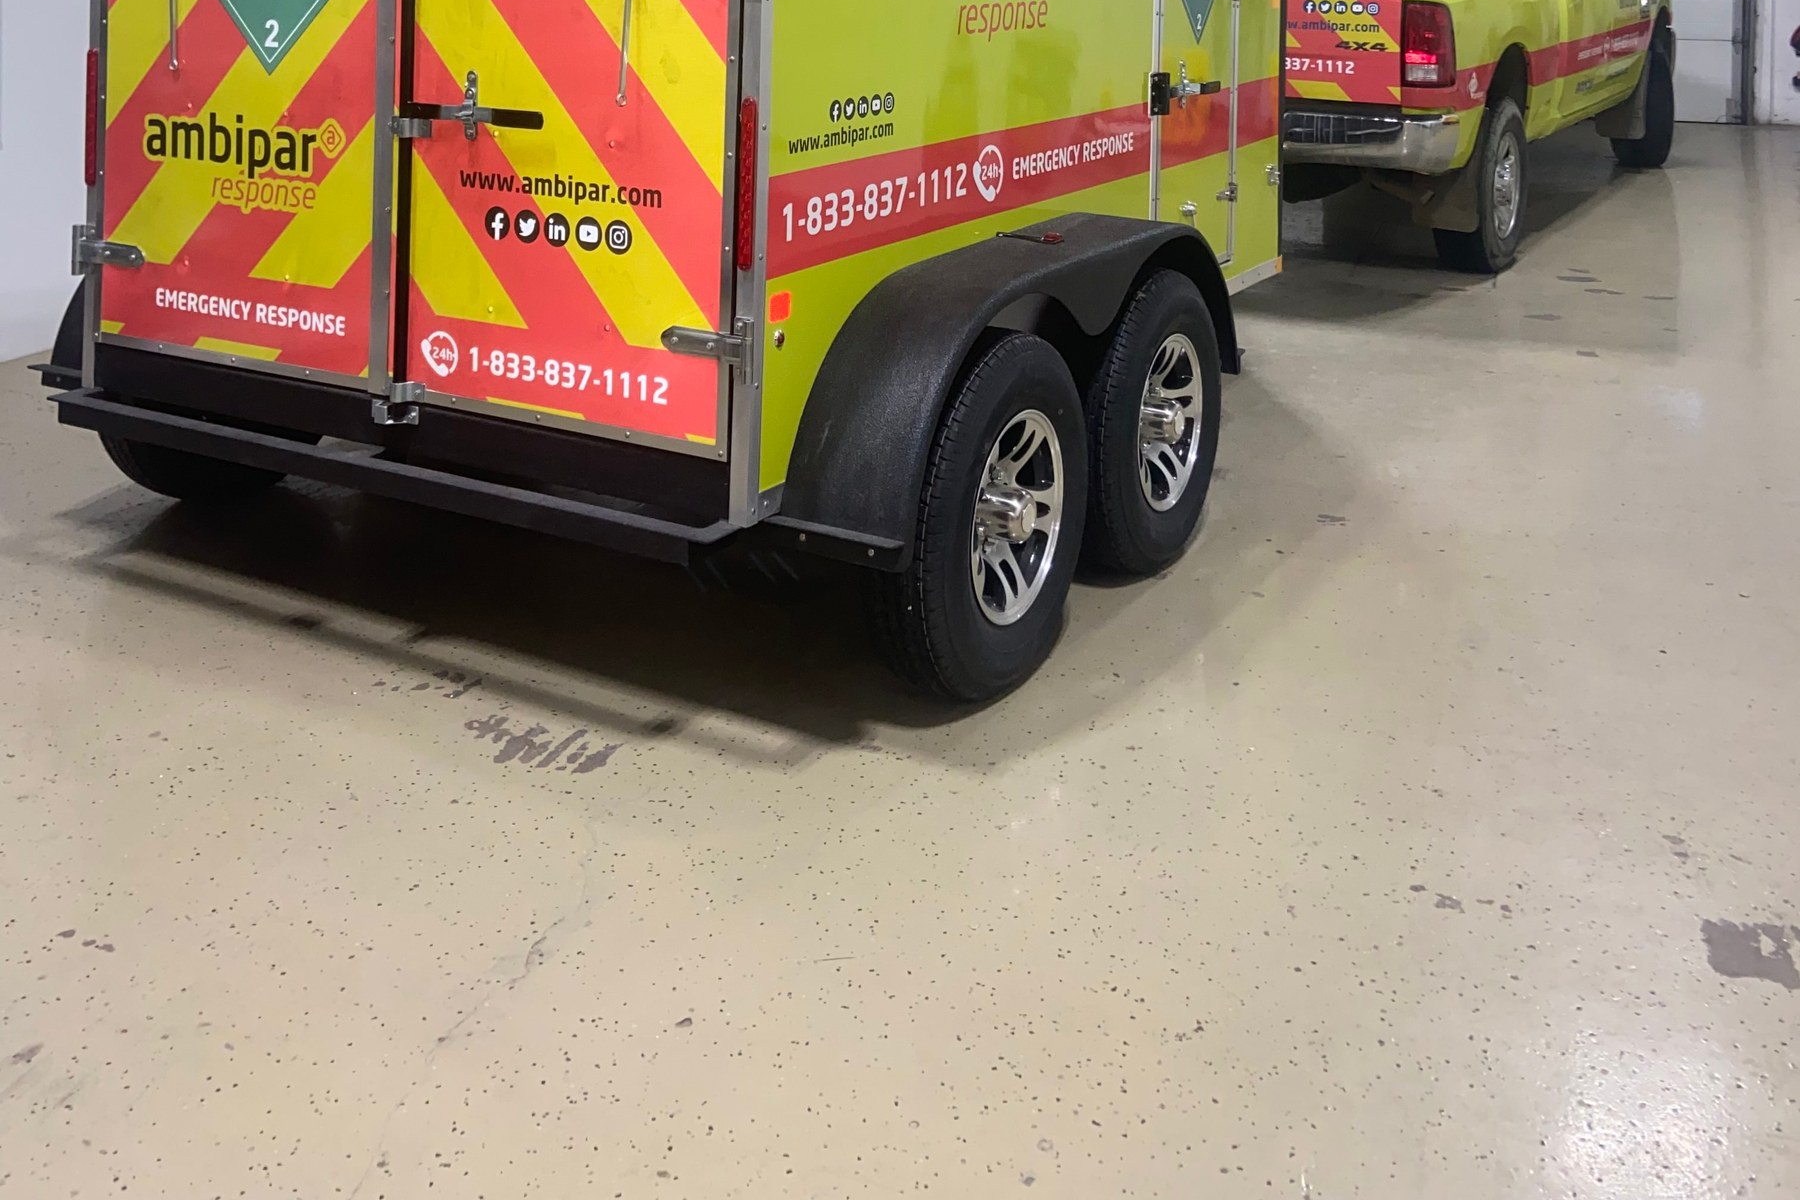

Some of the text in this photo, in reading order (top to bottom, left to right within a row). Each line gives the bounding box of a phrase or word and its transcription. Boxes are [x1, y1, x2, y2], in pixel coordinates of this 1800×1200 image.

[264, 19, 279, 48] 2
[957, 0, 1048, 42] response
[1196, 13, 1202, 30] 2
[146, 112, 317, 179] ambipar
[788, 122, 894, 154] www.ambipar.com
[211, 175, 316, 209] response
[460, 170, 662, 208] www.ambipar.com
[782, 132, 1134, 242] 1-833-837-1112 24h EMERGENCY RESPONSE
[155, 287, 346, 337] EMERGENCY RESPONSE
[432, 346, 669, 405] 24h 1-833-837-1112
